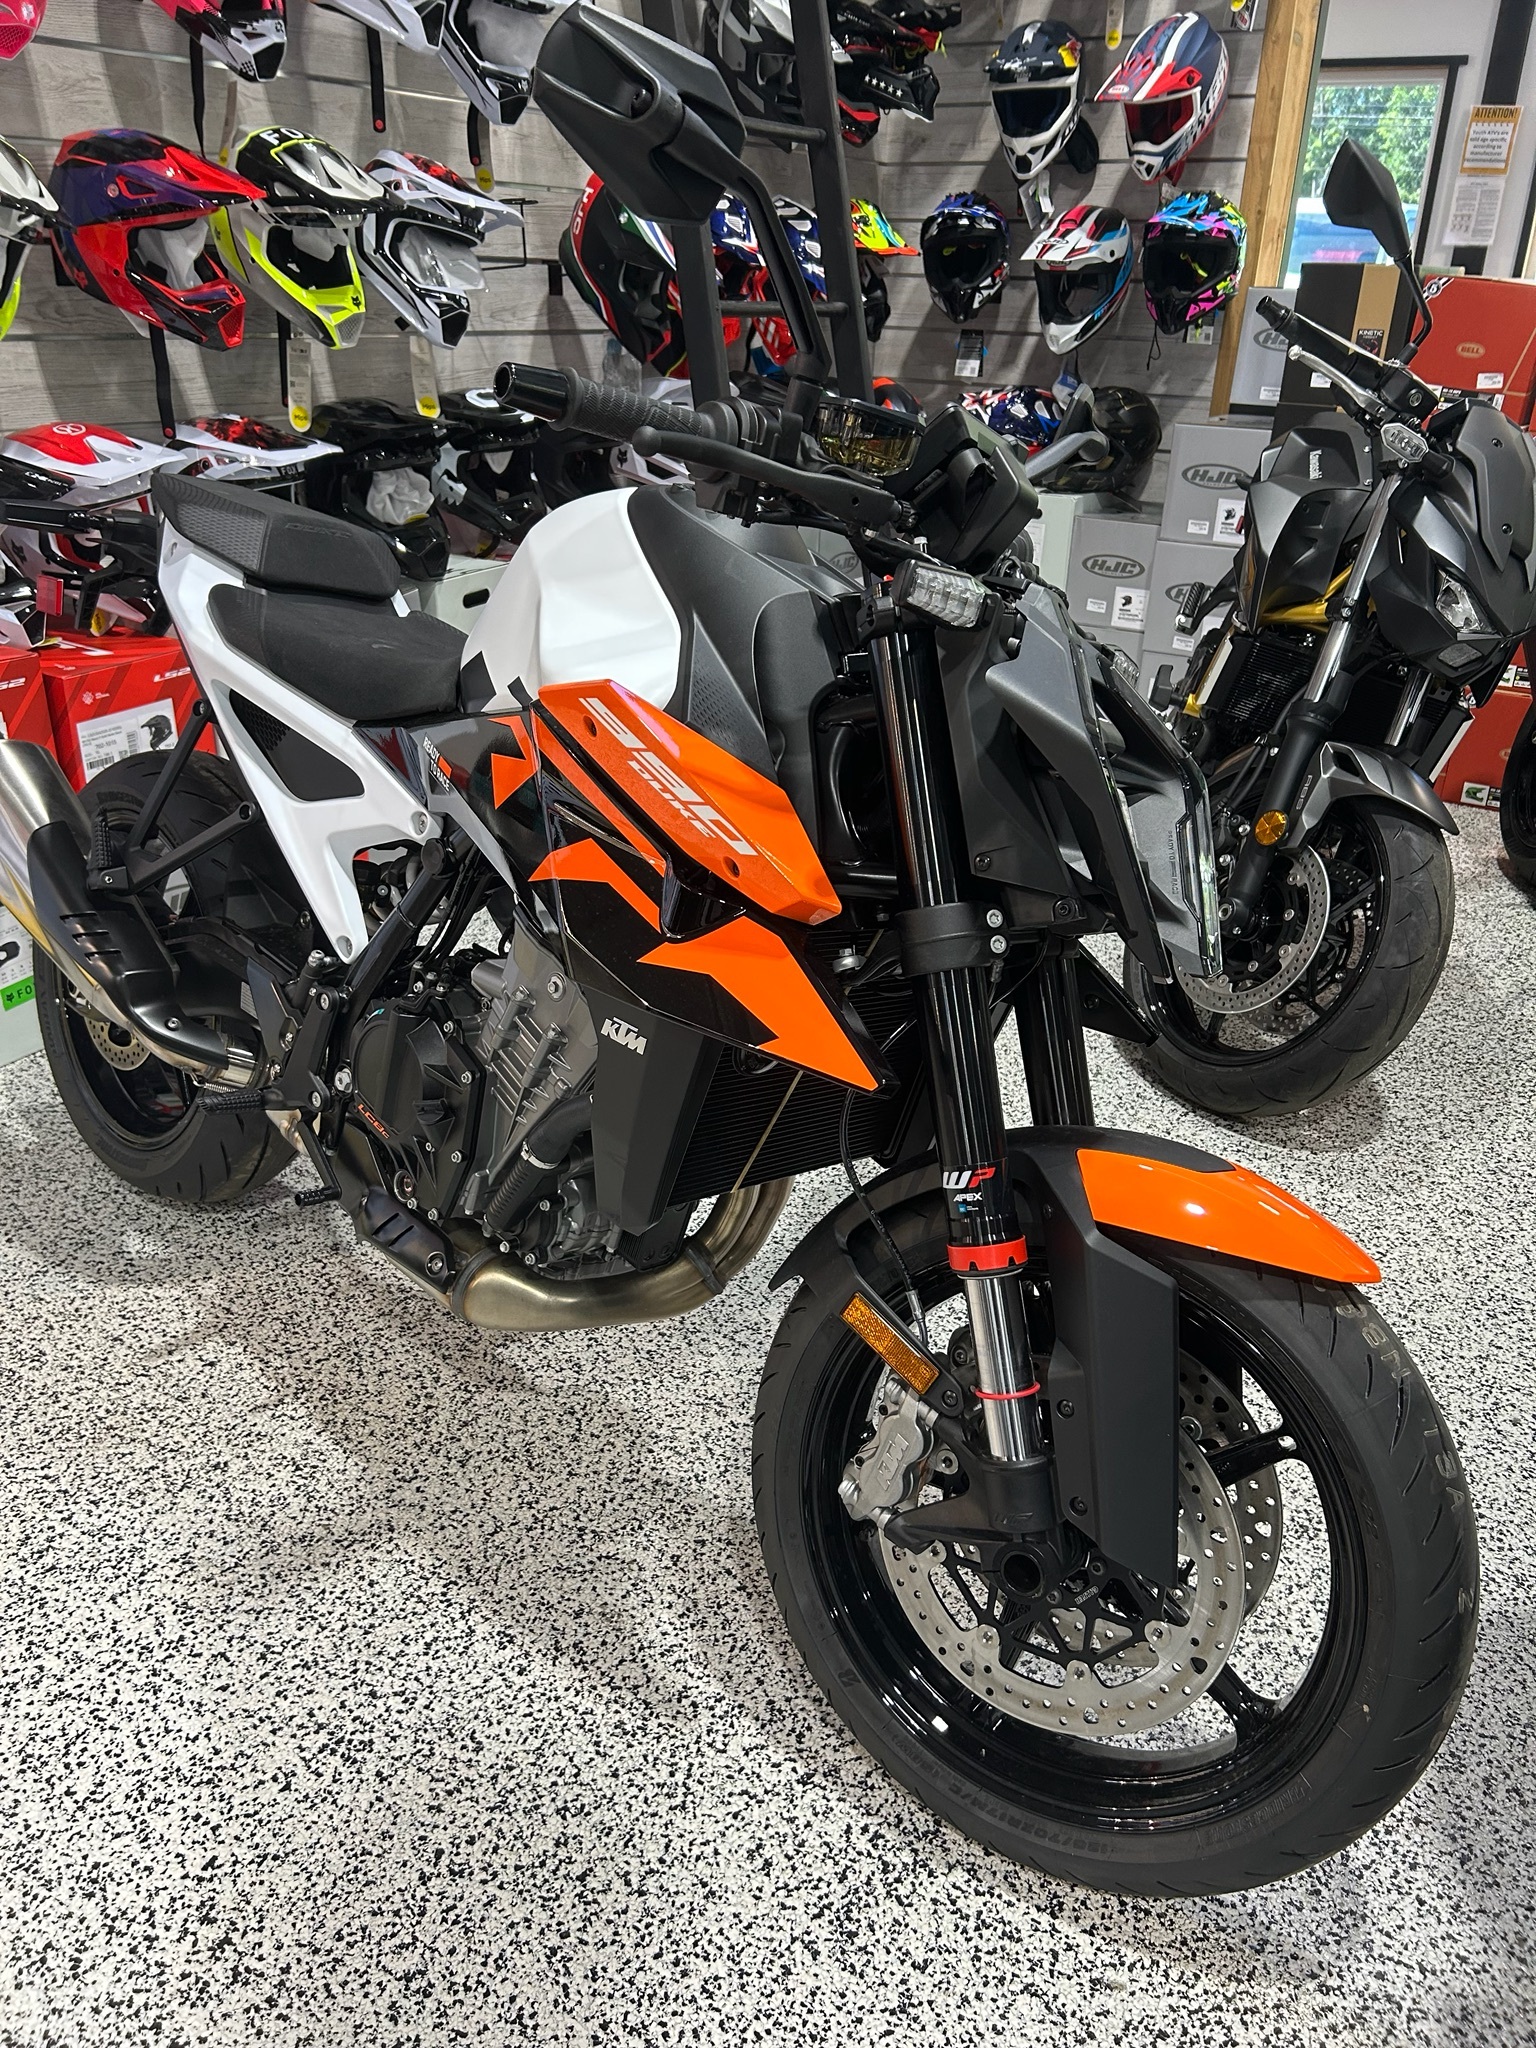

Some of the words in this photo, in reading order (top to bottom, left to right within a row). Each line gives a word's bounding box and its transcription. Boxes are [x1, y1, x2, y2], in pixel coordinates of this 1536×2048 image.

[1474, 107, 1518, 118] ATTENTION!
[1460, 346, 1480, 354] BELL
[1309, 450, 1323, 480] Kawasaki
[1190, 469, 1242, 484] HJC
[1090, 559, 1137, 574] HJC
[153, 666, 191, 683] LS2
[423, 736, 440, 763] READY
[430, 759, 438, 776] TO
[436, 767, 450, 792] RACE
[626, 760, 718, 838] DUKE
[1296, 775, 1313, 809] ABS
[16, 984, 33, 999] FO
[601, 1016, 648, 1056] KTM
[943, 1167, 996, 1189] WP
[953, 1192, 983, 1202] APEX
[876, 1433, 910, 1492] KTM
